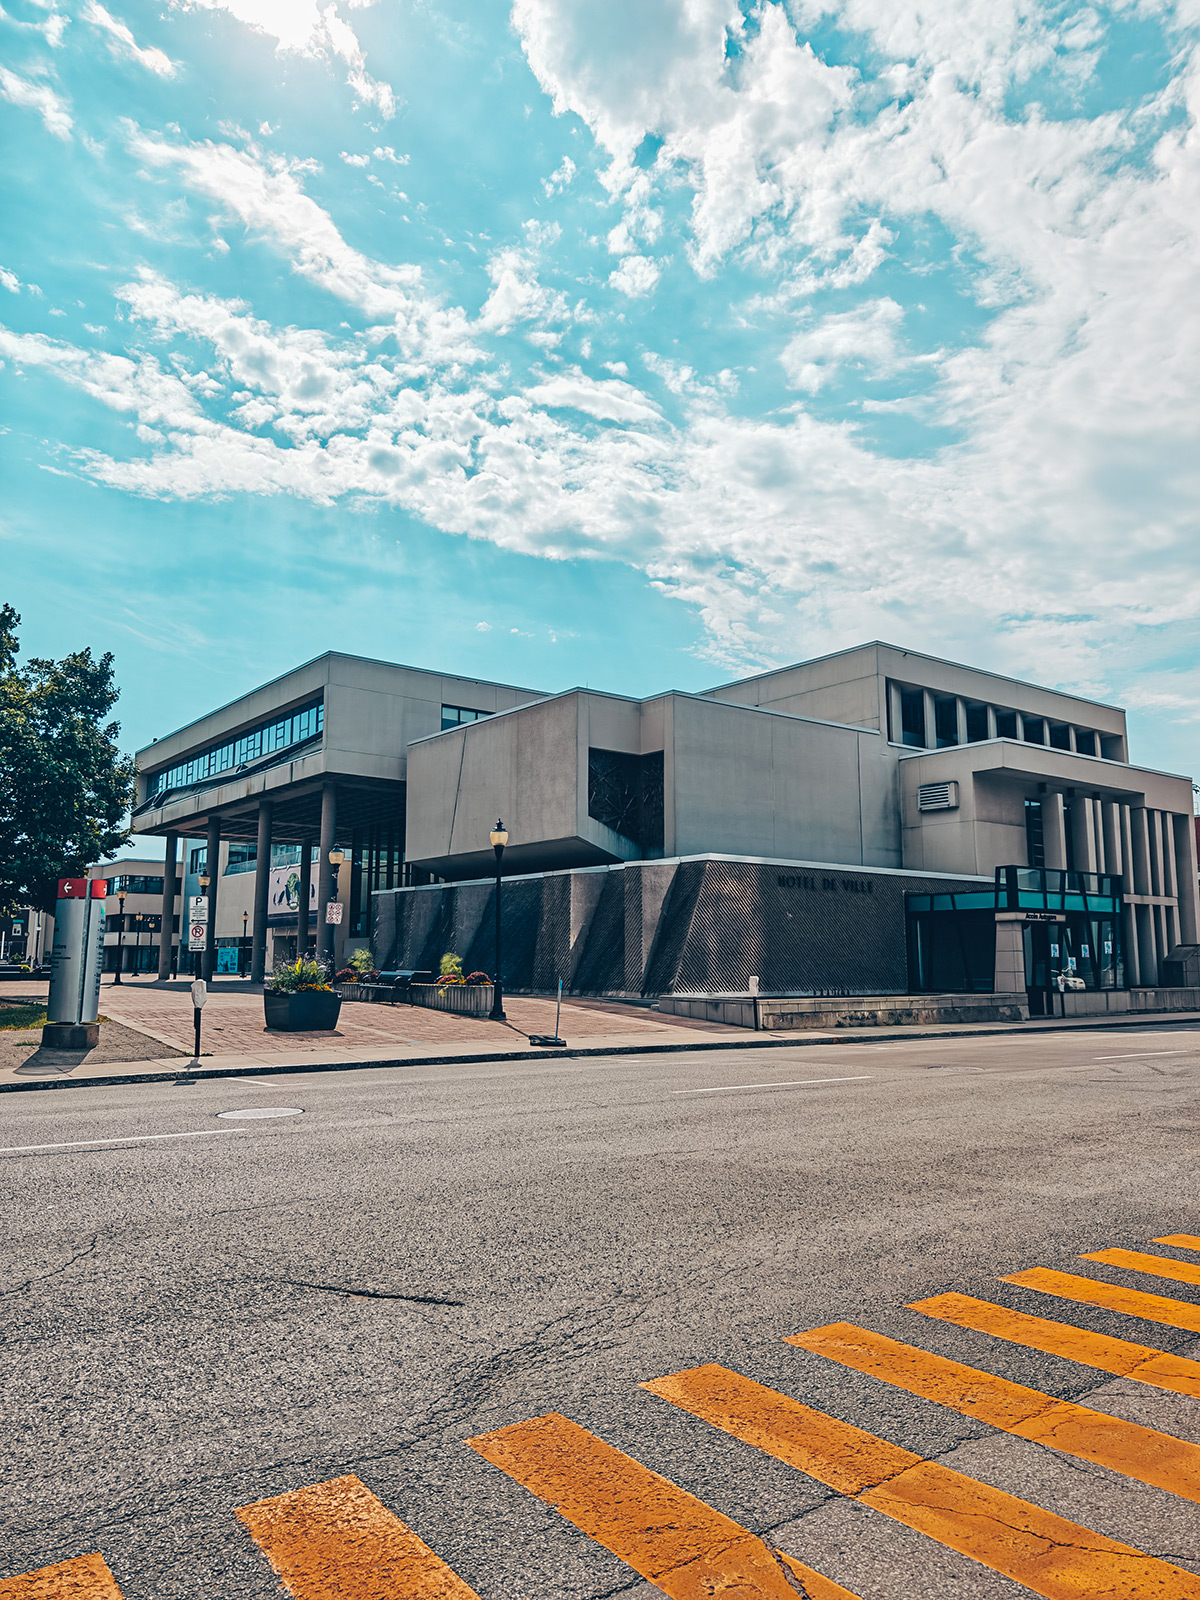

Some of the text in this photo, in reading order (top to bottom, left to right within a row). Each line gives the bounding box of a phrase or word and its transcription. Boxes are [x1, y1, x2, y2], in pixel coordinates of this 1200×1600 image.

[823, 878, 836, 891] DE
[842, 880, 873, 893] VILLE
[195, 896, 203, 905] P
